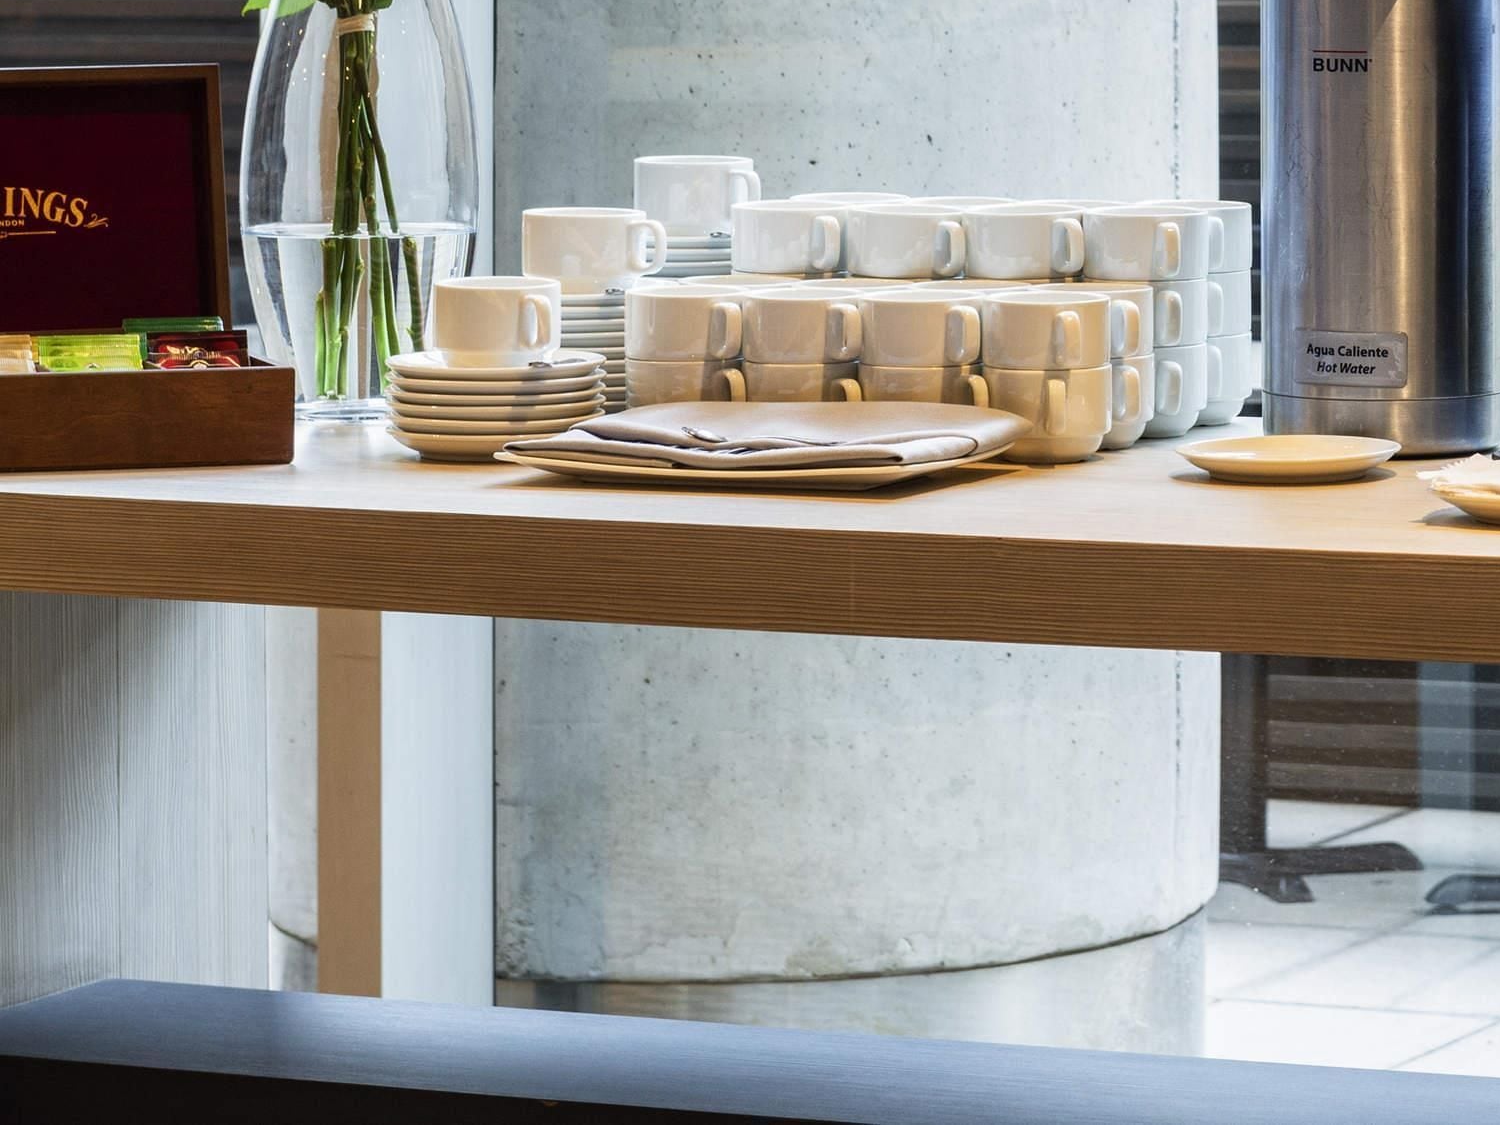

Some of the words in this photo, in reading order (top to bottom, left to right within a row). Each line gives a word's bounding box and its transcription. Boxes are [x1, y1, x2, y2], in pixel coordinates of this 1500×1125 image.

[1313, 58, 1368, 72] BUNN
[1306, 343, 1335, 357] Agua
[1337, 346, 1389, 358] Caliente
[1317, 361, 1337, 373] Hot
[1340, 363, 1376, 375] Water
